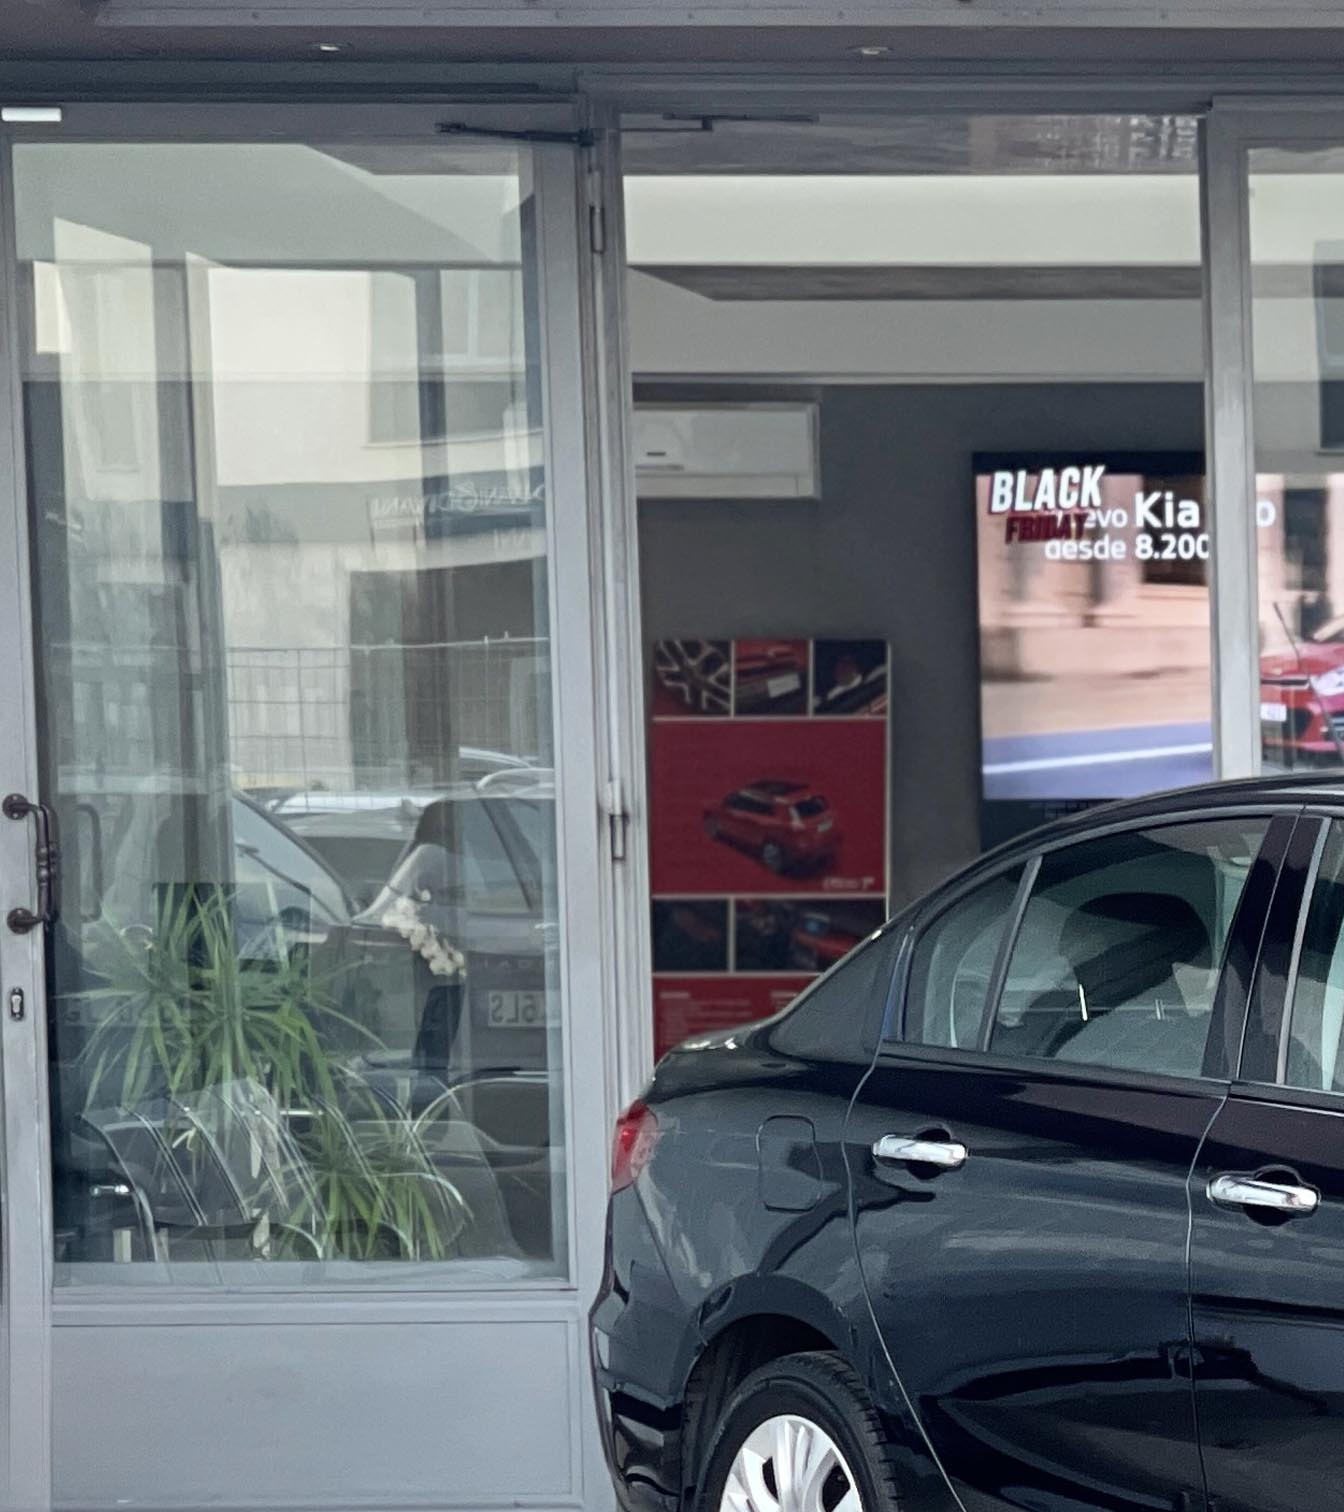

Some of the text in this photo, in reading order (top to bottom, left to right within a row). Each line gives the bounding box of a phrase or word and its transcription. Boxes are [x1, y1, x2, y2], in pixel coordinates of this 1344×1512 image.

[990, 465, 1106, 515] BLACK
[1134, 492, 1200, 529] Kia
[1045, 535, 1127, 560] desde
